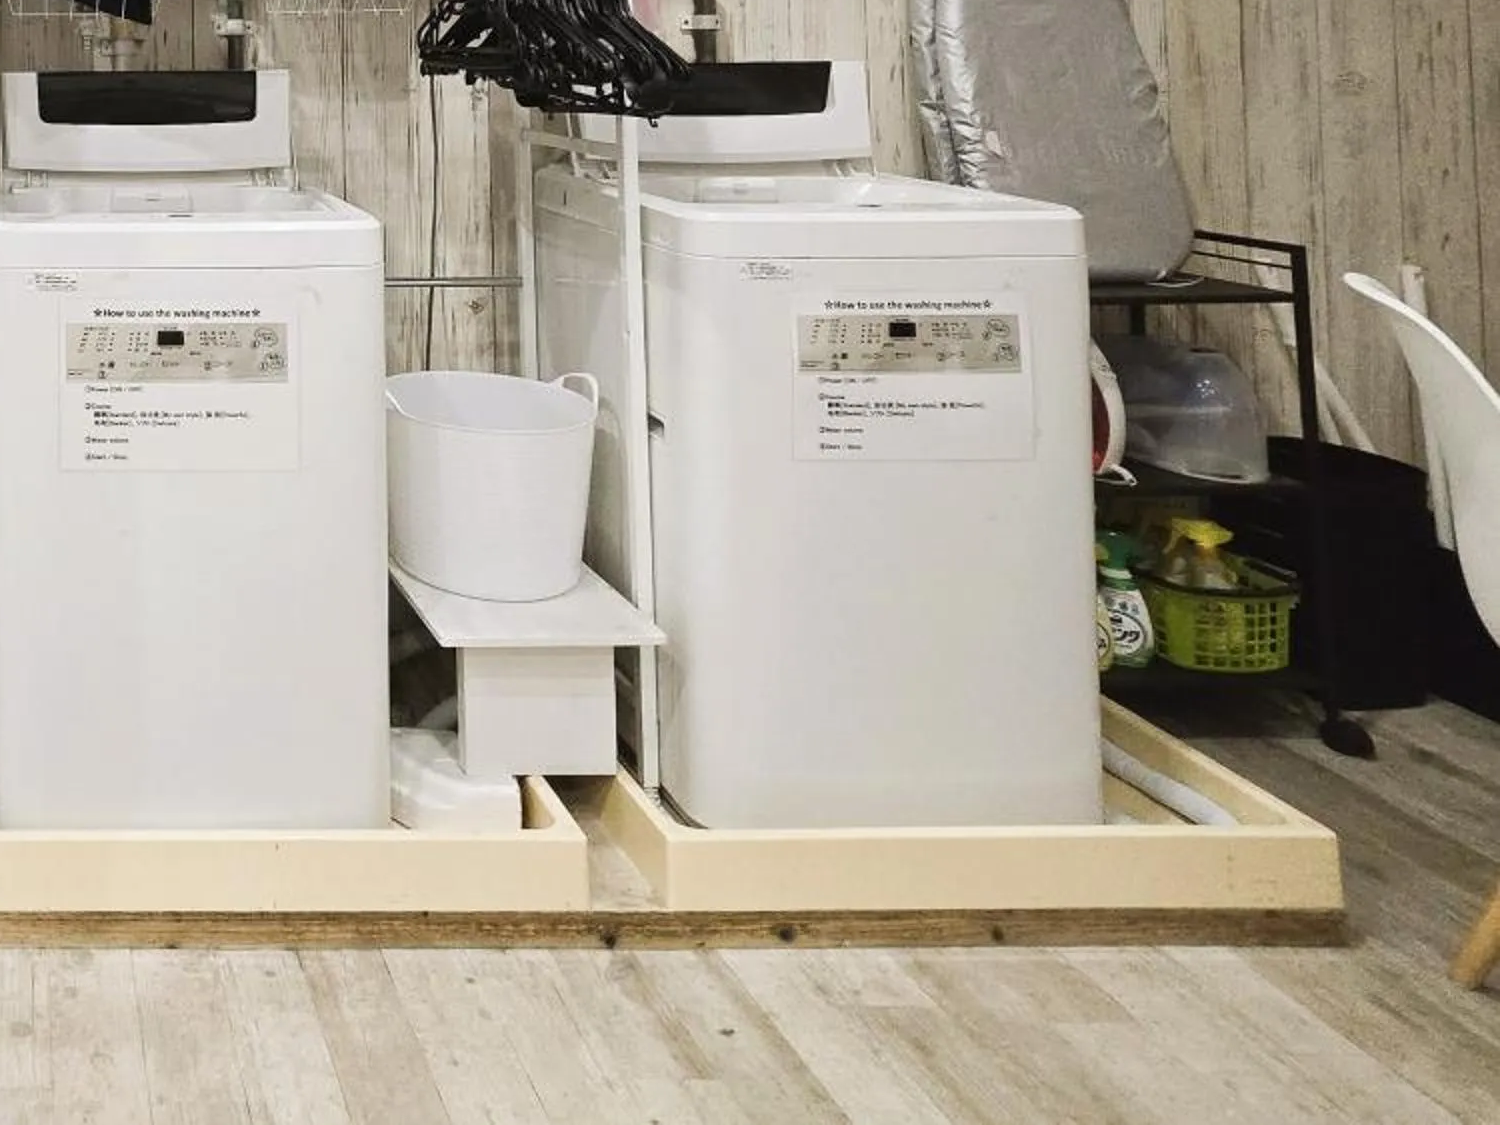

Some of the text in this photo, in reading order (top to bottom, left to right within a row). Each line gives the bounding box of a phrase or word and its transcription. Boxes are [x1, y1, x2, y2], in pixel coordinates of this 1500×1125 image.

[834, 300, 855, 310] How
[857, 300, 868, 310] to
[887, 300, 901, 310] the
[905, 300, 941, 311] washing
[943, 300, 981, 310] machine
[156, 309, 171, 318] the
[174, 308, 210, 320] washing
[212, 308, 251, 318] machine
